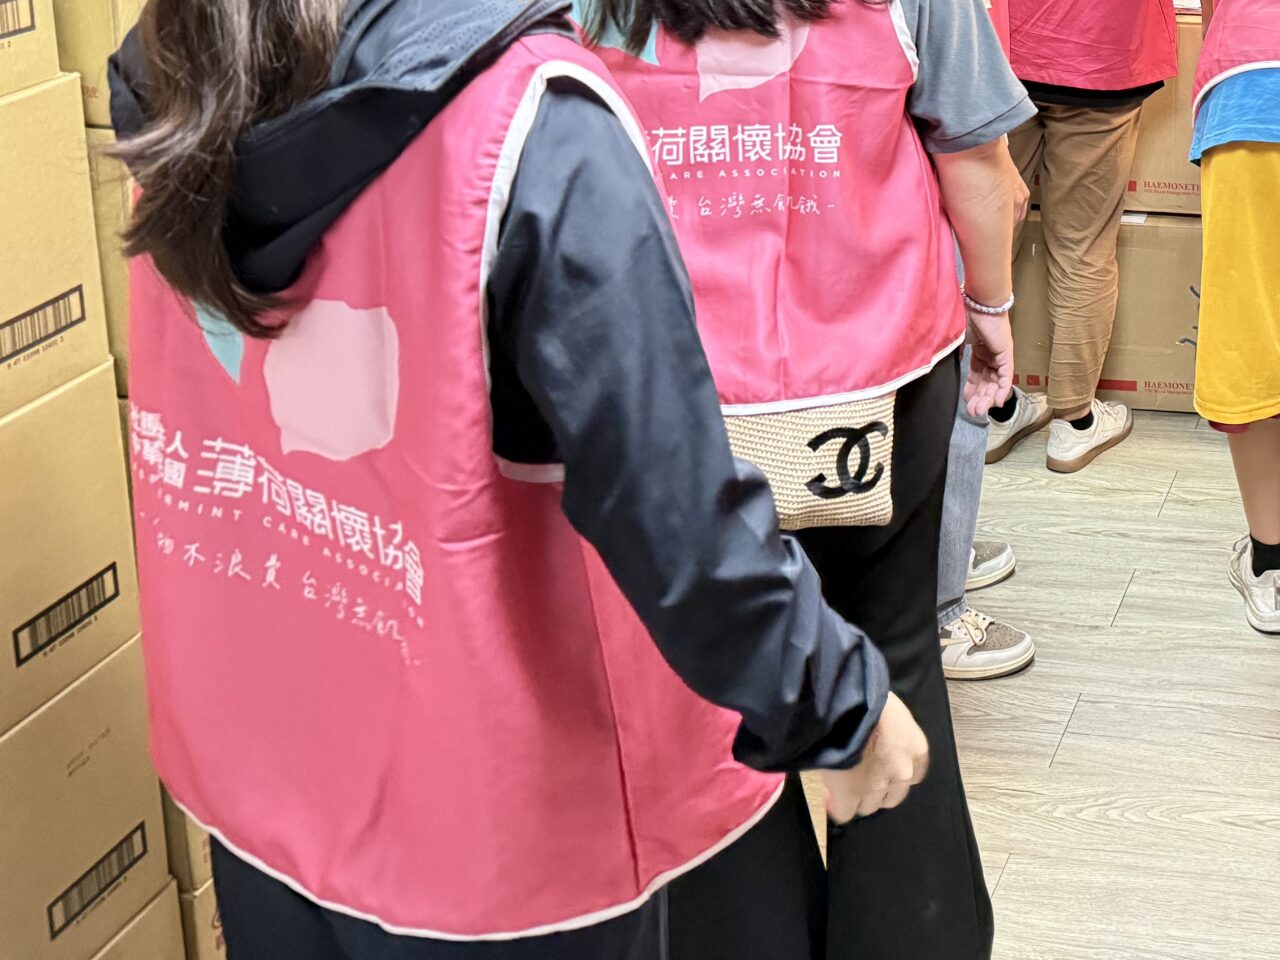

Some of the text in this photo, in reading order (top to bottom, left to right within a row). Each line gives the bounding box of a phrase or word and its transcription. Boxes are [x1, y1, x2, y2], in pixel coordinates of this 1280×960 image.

[644, 122, 843, 165] 荷關懷協會
[661, 171, 704, 181] ARE
[1144, 380, 1195, 391] HAEMONE
